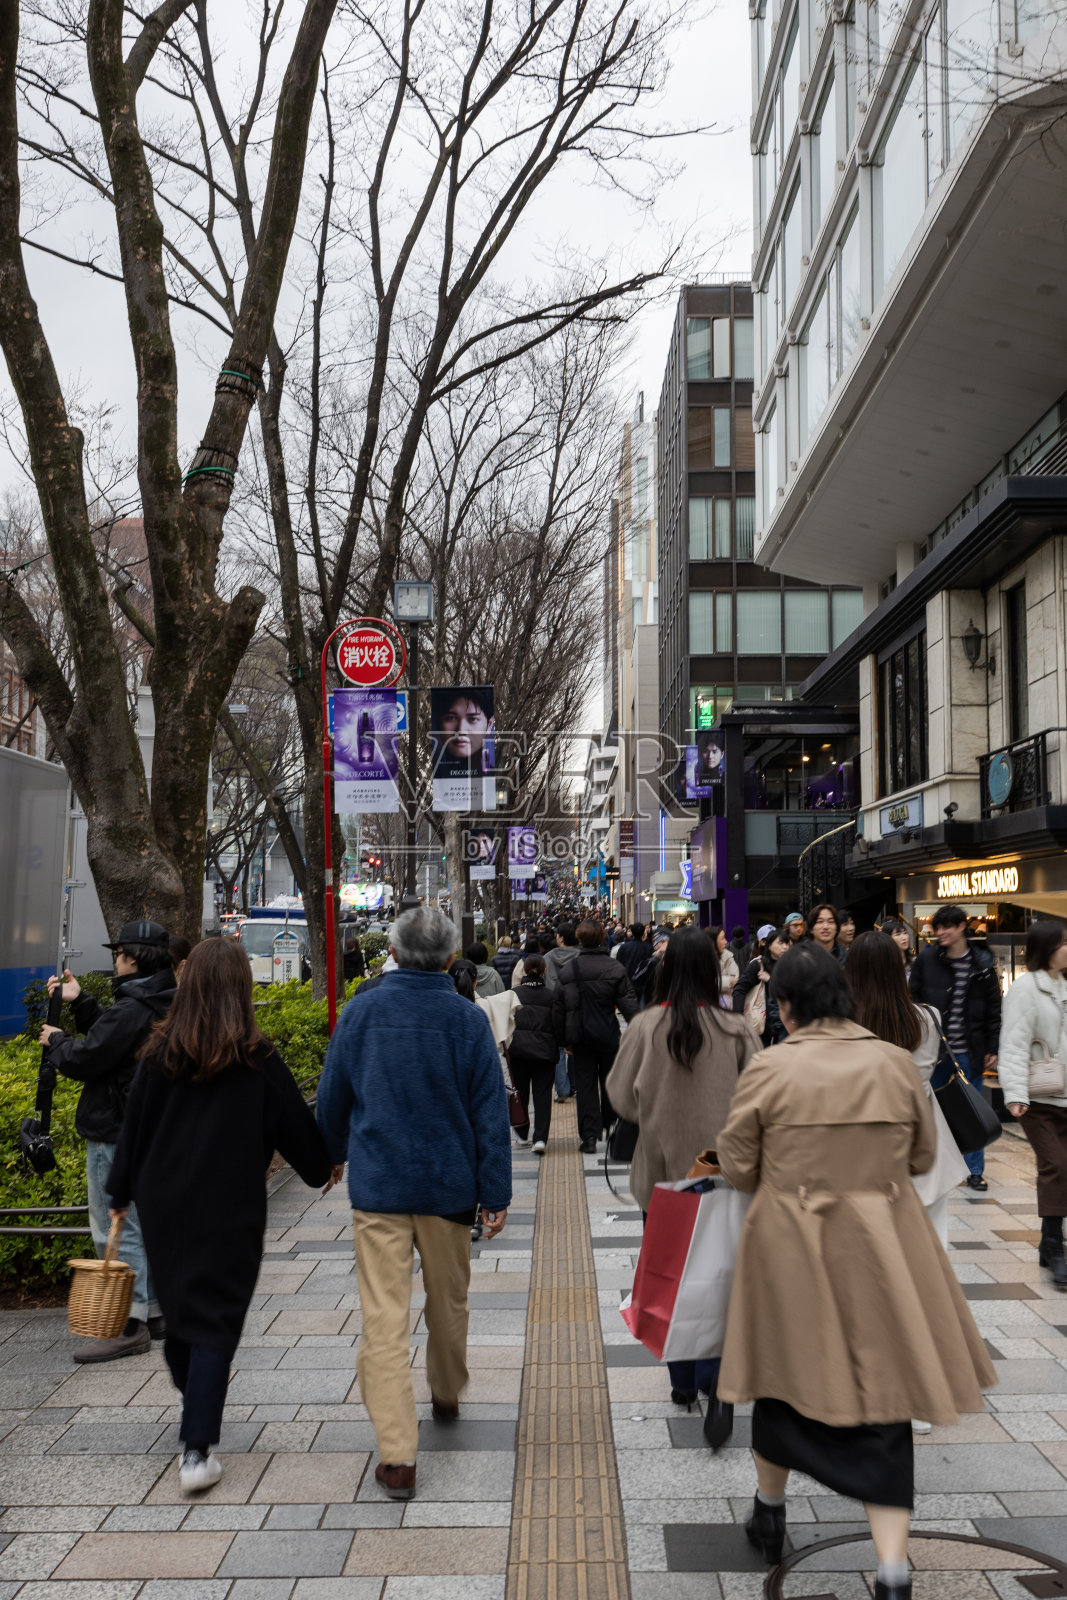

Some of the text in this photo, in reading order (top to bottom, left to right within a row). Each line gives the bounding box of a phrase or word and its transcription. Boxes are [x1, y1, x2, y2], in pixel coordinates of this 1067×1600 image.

[347, 635, 385, 644] FIRE HYDRANT
[344, 645, 391, 668] 消火栓
[937, 866, 1019, 898] JOURNAL STANDARD
